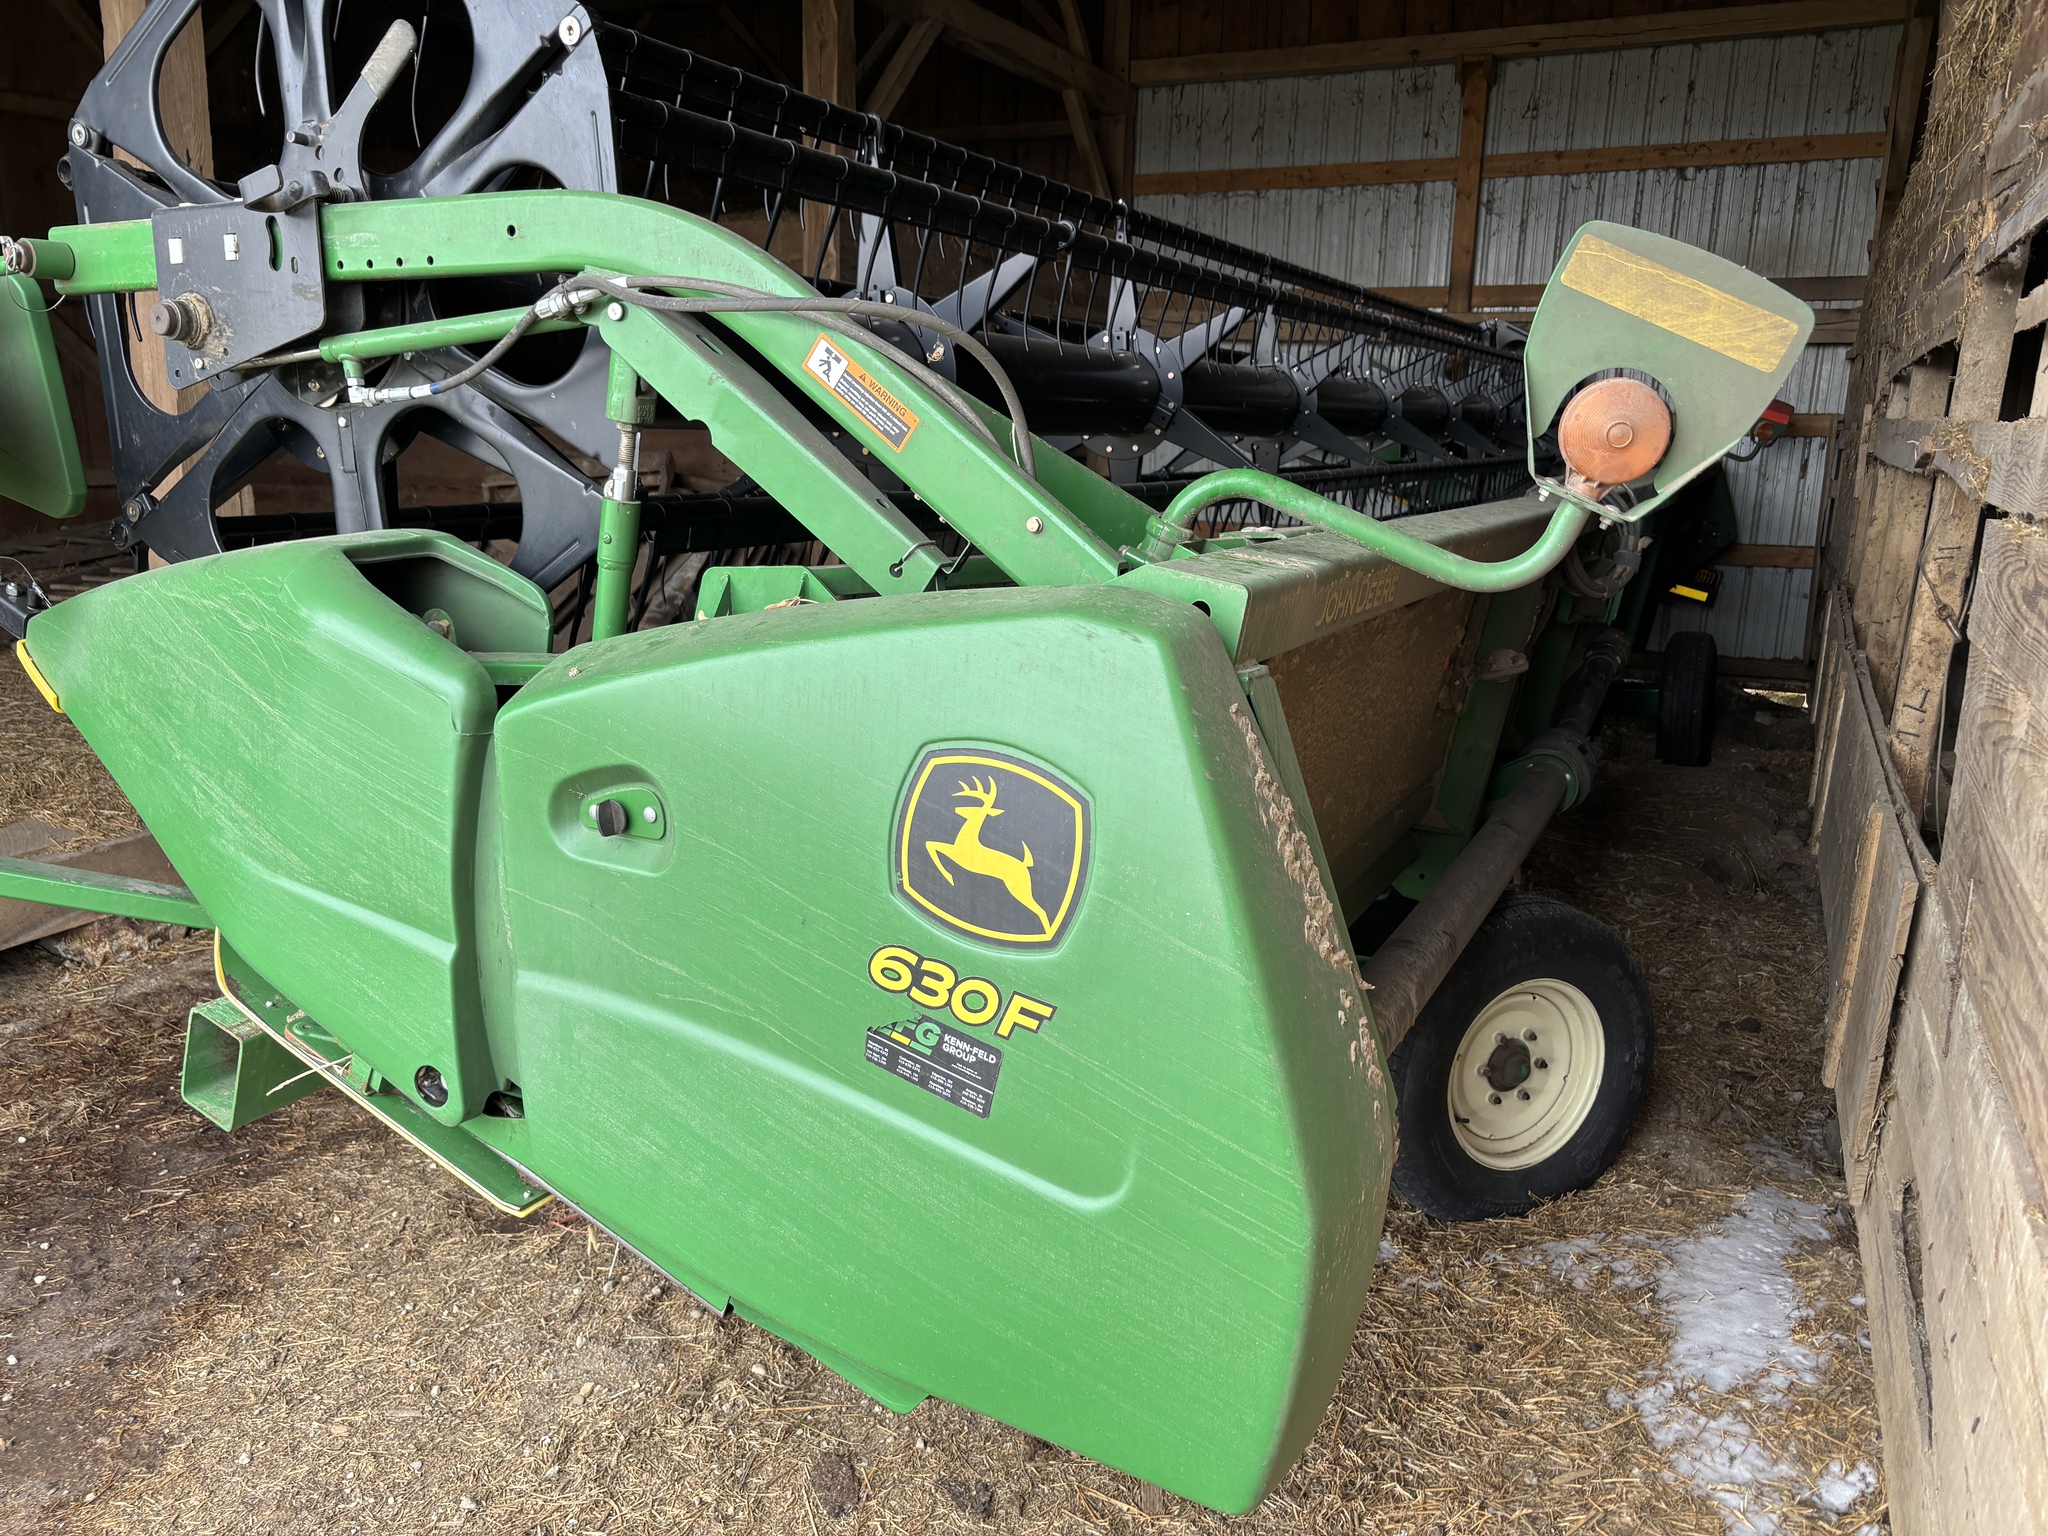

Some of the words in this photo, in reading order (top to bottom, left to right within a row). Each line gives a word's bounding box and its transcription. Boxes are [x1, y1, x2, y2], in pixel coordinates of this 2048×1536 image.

[869, 379, 907, 417] WARNING
[1315, 584, 1358, 627] JOHN
[1356, 575, 1400, 612] DEERE
[867, 943, 1058, 1041] 630F
[942, 1043, 977, 1064] GROUP
[943, 1032, 997, 1064] KENN-FELD
